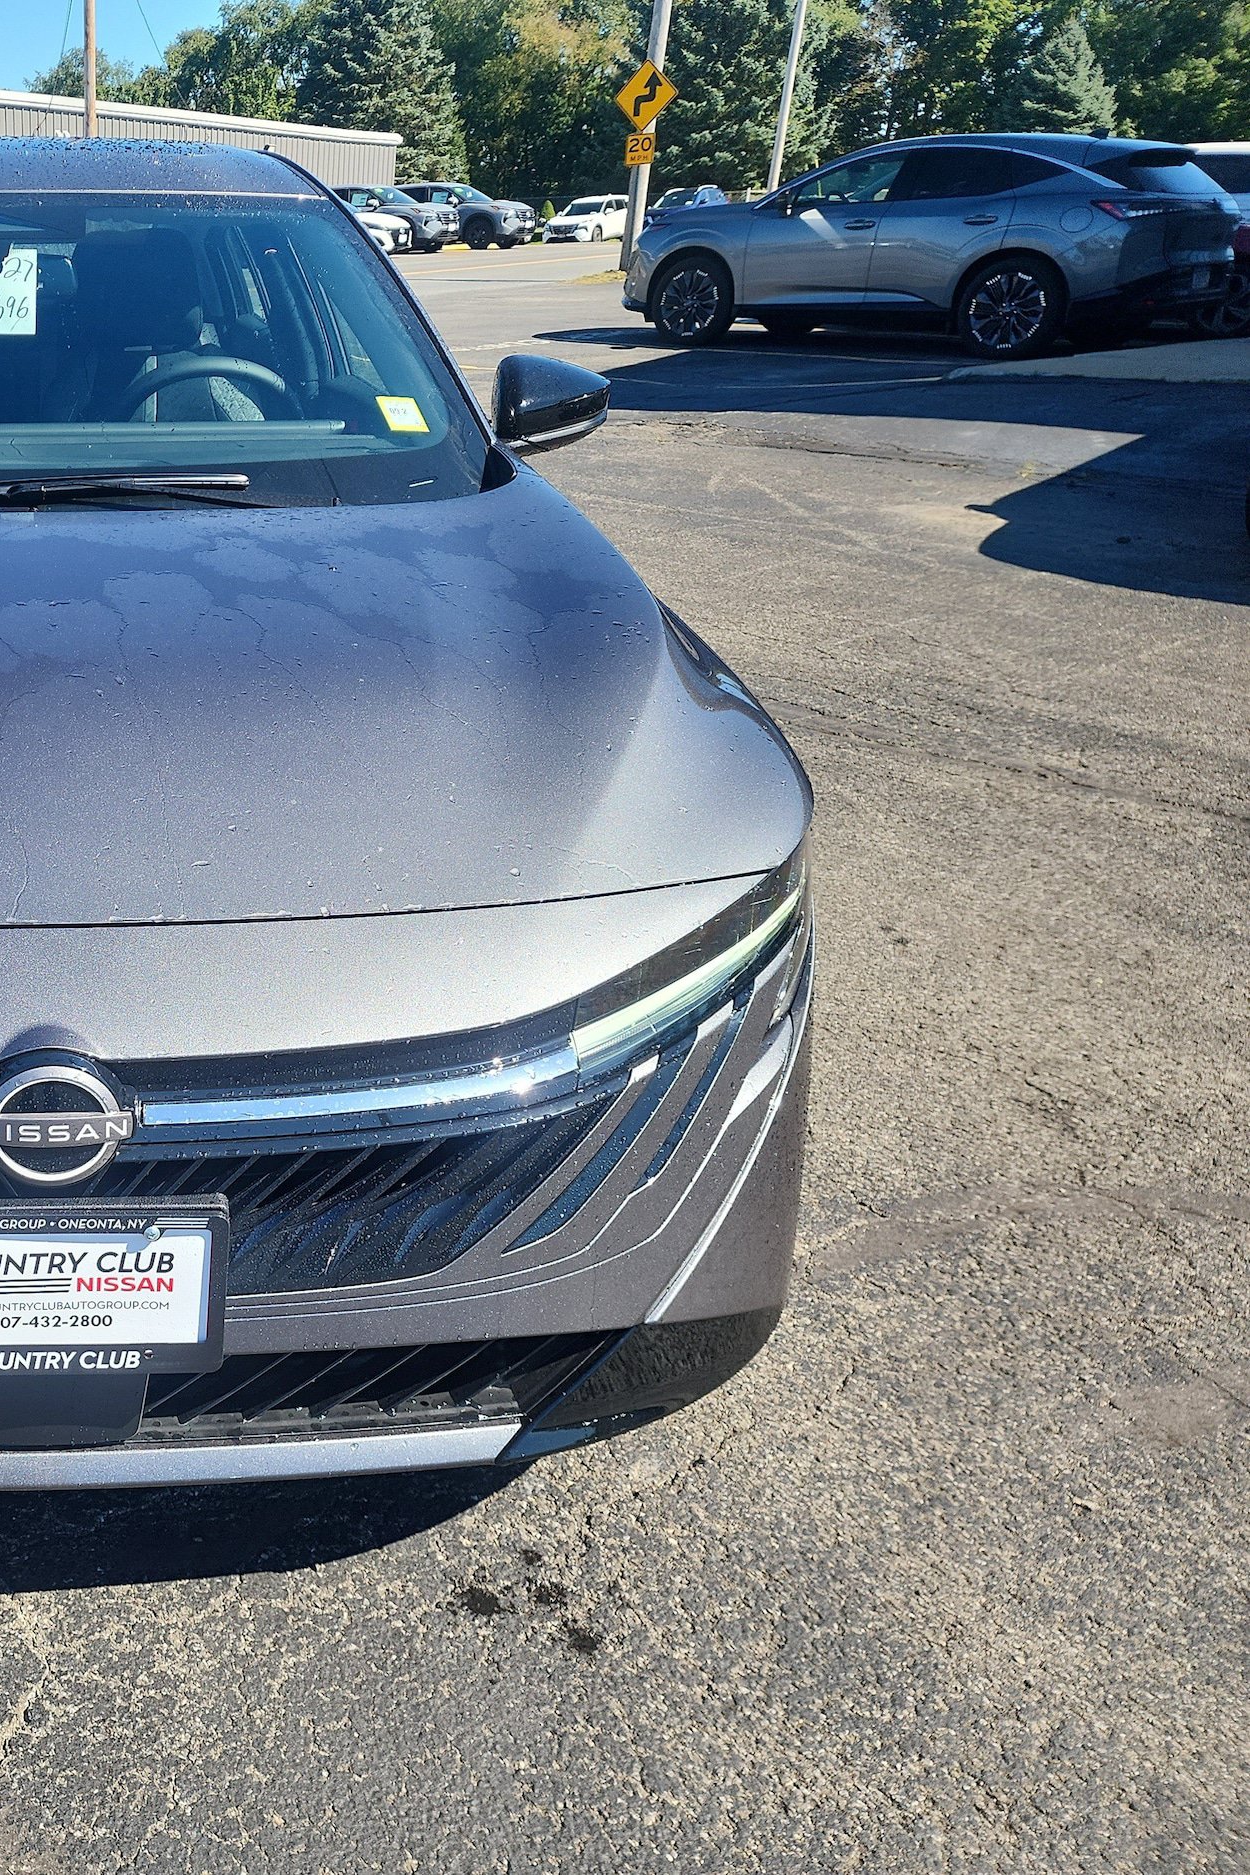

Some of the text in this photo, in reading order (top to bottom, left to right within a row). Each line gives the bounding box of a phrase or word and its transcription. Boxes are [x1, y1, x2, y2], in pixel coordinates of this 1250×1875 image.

[629, 137, 652, 152] 20
[3, 257, 34, 282] 27
[0, 1218, 47, 1231] GROUP
[96, 1251, 175, 1274] CLUB
[76, 1276, 175, 1293] NISSAN
[79, 1350, 141, 1370] CLUB
